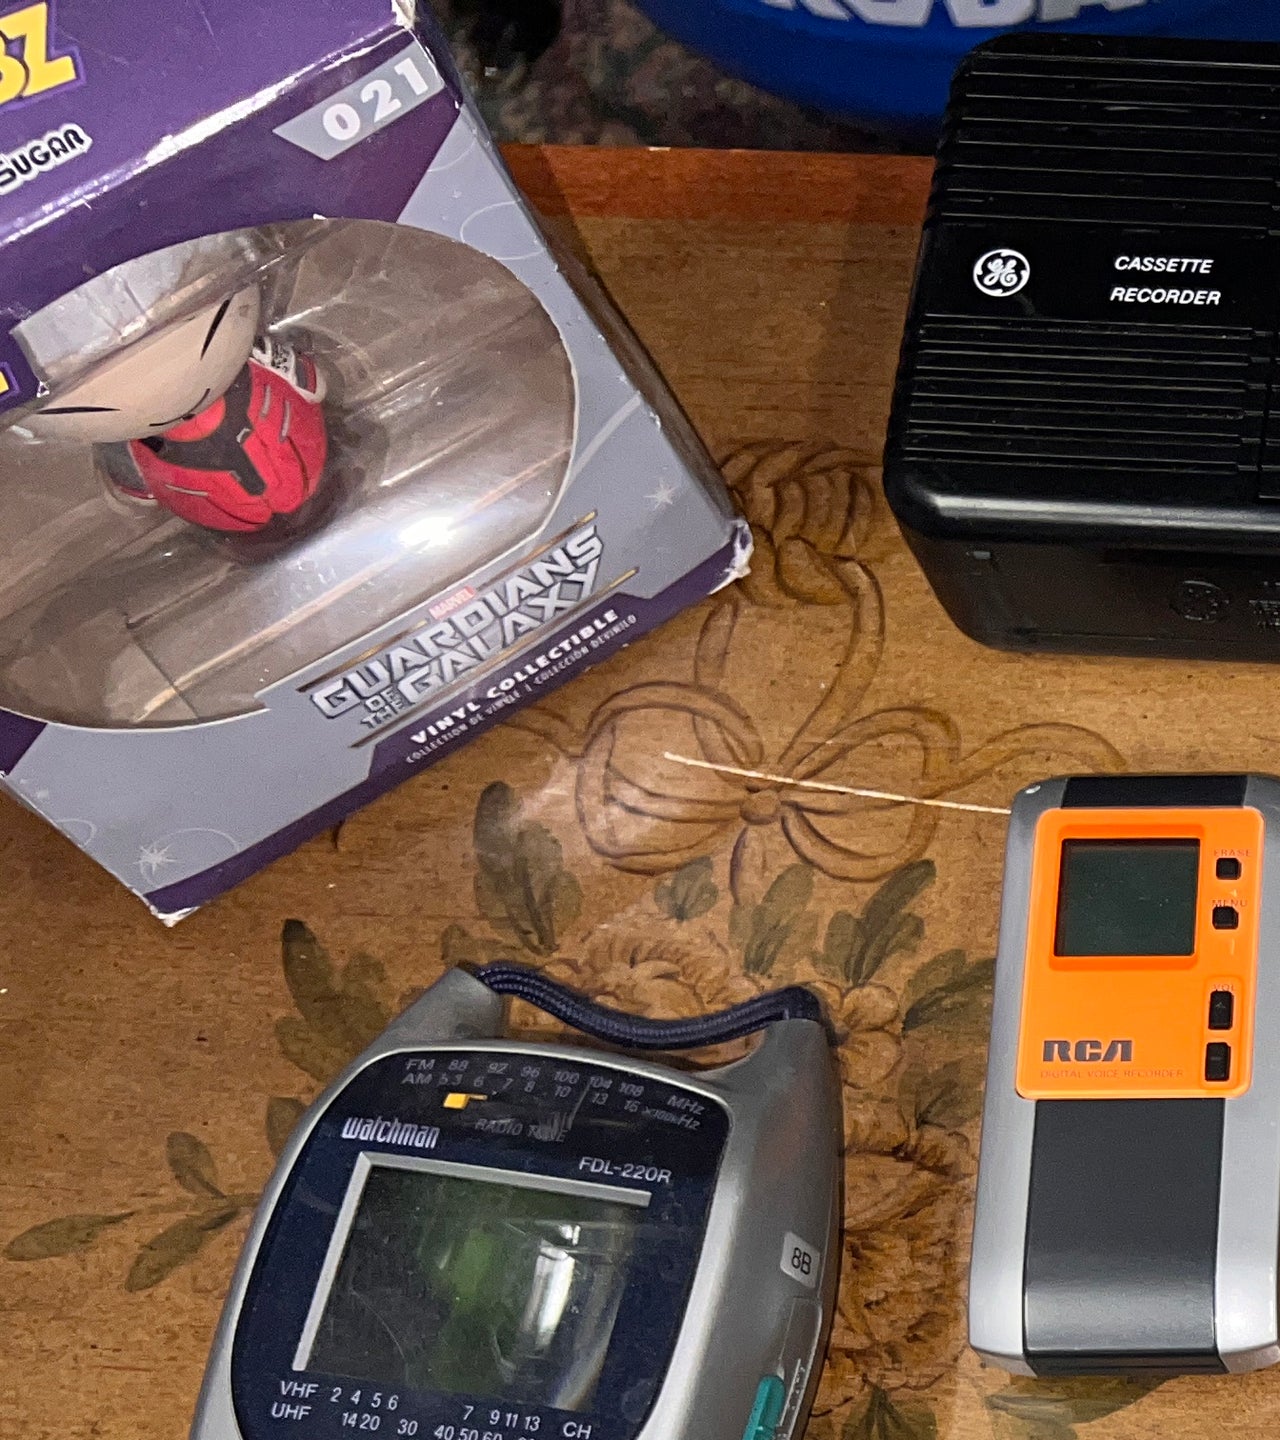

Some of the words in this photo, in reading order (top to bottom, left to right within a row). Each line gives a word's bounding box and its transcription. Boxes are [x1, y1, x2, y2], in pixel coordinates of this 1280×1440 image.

[323, 58, 428, 140] 021
[1114, 256, 1214, 274] CASSETTE
[1110, 287, 1221, 305] RECORDER
[311, 525, 603, 719] GUARDIANS
[400, 559, 600, 704] GALAXY
[410, 701, 481, 744] VINYL
[487, 609, 619, 700] COLLECTIBLE
[1212, 899, 1248, 908] MENU
[406, 1059, 436, 1070] FM
[448, 1060, 469, 1071] 88
[1042, 1040, 1132, 1062] RCA
[402, 1073, 433, 1084] AM
[1041, 1069, 1082, 1079] DIGITAL
[1087, 1069, 1119, 1079] VOICE
[1124, 1069, 1183, 1079] RECORDER
[342, 1116, 440, 1148] watchman
[475, 1118, 523, 1136] RADIO
[579, 1156, 672, 1184] FDL-220R
[790, 1245, 811, 1277] 8B
[271, 1401, 312, 1421] UHF
[342, 1411, 358, 1427] 14
[359, 1415, 380, 1431] 20
[397, 1419, 418, 1436] 30
[434, 1425, 455, 1440] 40
[280, 1380, 318, 1398] VHF
[330, 1387, 342, 1403] 2
[350, 1390, 361, 1405] 4
[370, 1392, 382, 1408] 5
[387, 1394, 399, 1410] 6
[462, 1405, 474, 1420] 7
[489, 1410, 501, 1425] 9
[505, 1413, 518, 1428] 11
[524, 1416, 541, 1431] 13
[563, 1421, 592, 1440] CH
